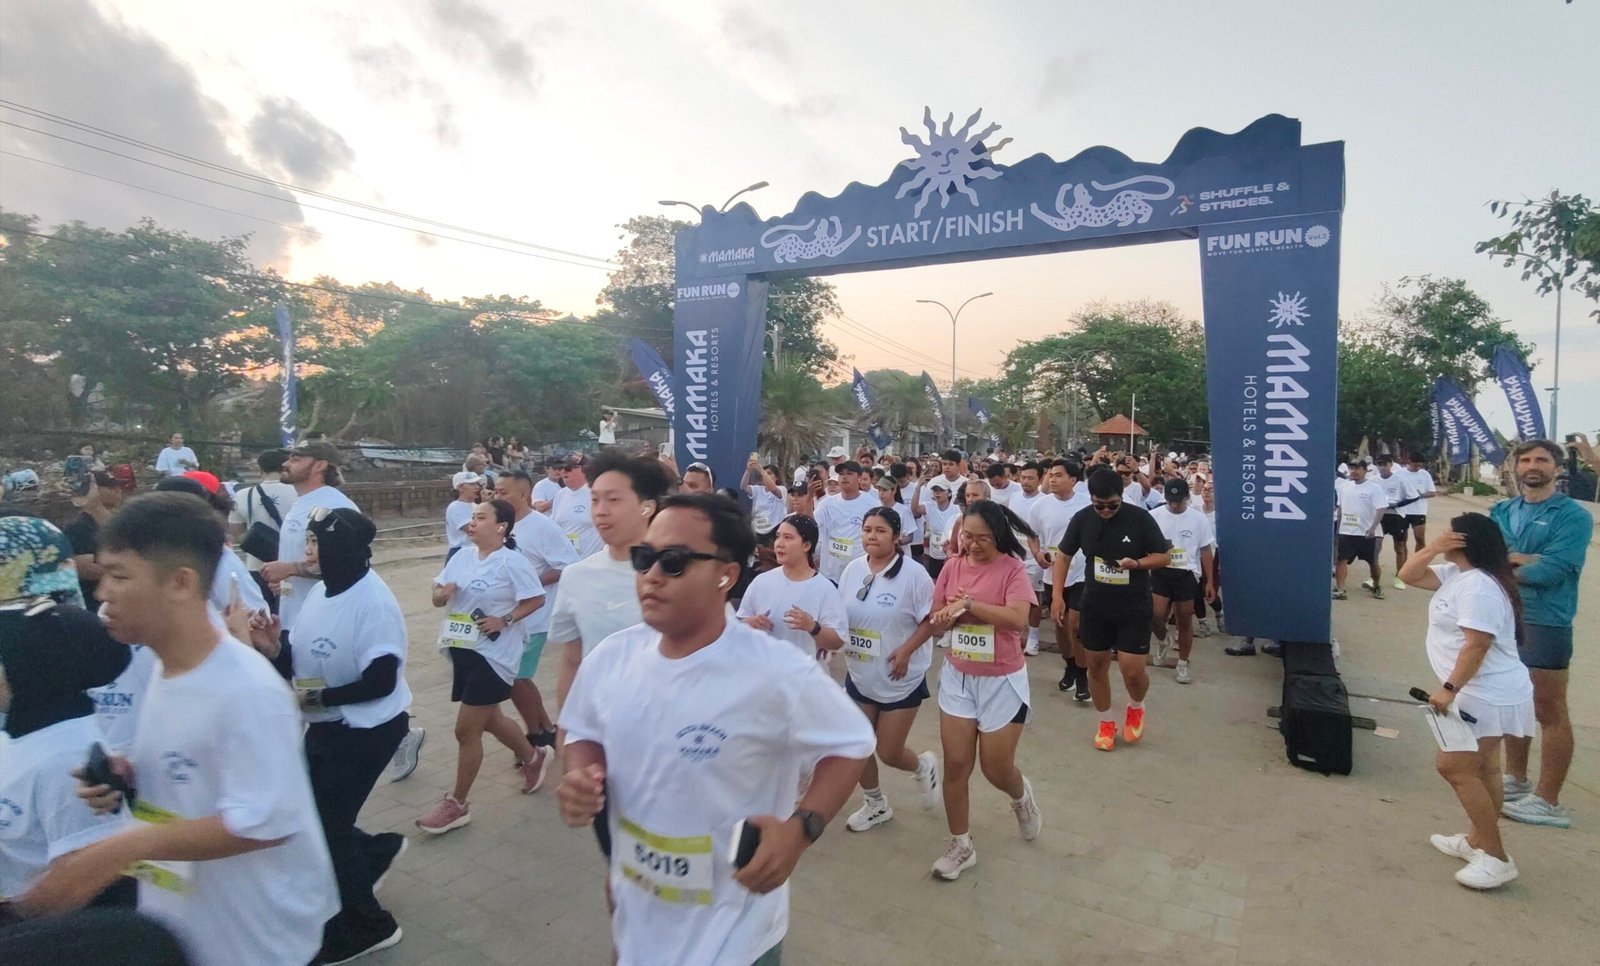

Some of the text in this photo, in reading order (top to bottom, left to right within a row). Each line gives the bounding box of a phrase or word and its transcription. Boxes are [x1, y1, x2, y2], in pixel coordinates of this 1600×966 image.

[1200, 182, 1290, 200] SHUFFLE &
[1200, 196, 1274, 212] STRIDES.
[867, 209, 1023, 247] START/FINISH
[1207, 228, 1302, 252] FUN RUN
[708, 247, 755, 263] MAMAKA
[677, 286, 700, 299] FUN
[701, 284, 726, 297] RUN
[711, 327, 719, 375] RESORTS
[686, 330, 708, 460] MAMAKA
[1504, 375, 1537, 437] MAMAKA
[711, 391, 719, 432] HOTELS
[1445, 397, 1488, 443] MAMAKA
[1263, 334, 1311, 521] MAMAKA
[1241, 375, 1258, 520] HOTELS & RESORTS
[832, 542, 848, 552] 5282
[449, 622, 472, 634] 5078
[850, 636, 872, 649] 5120
[958, 634, 986, 647] 5005
[634, 843, 689, 877] 5019
